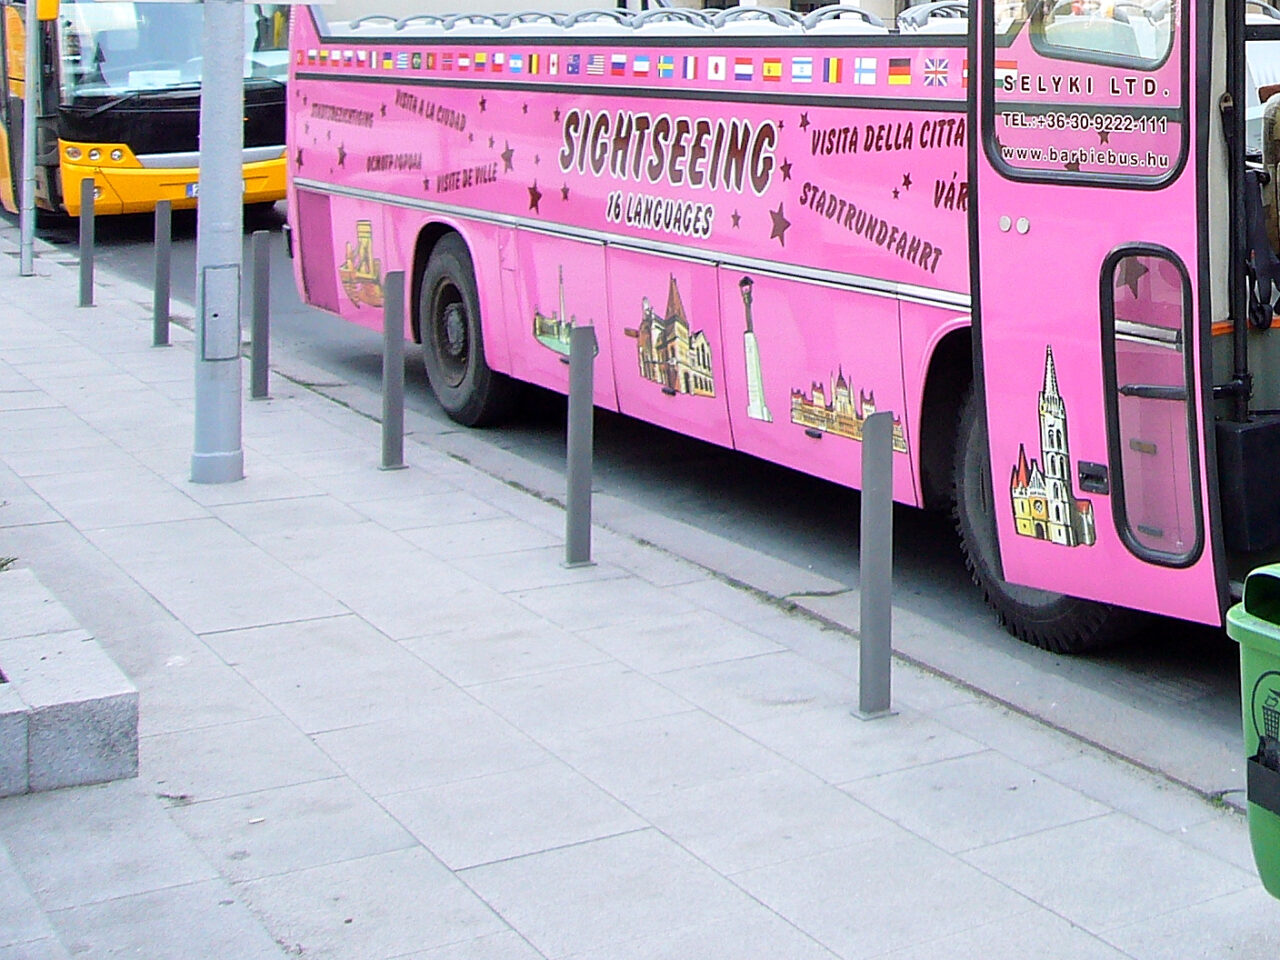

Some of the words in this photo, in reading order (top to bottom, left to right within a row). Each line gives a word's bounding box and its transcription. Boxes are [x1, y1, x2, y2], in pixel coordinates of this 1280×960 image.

[1003, 74, 1093, 94] SELYKI
[1110, 76, 1170, 97] LTD.
[437, 105, 467, 132] CIUDAD
[559, 109, 777, 195] SIGHTSEEING
[811, 126, 858, 156] VISITA
[863, 121, 913, 152] DELLA
[1002, 146, 1169, 168] www.barbiebus.hu
[437, 170, 461, 193] VISITE
[462, 168, 474, 189] DE
[475, 161, 498, 185] VILLE
[605, 191, 623, 224] 16
[625, 194, 715, 239] LANGUAGES
[799, 181, 943, 275] STADTRUNDFAHRT
